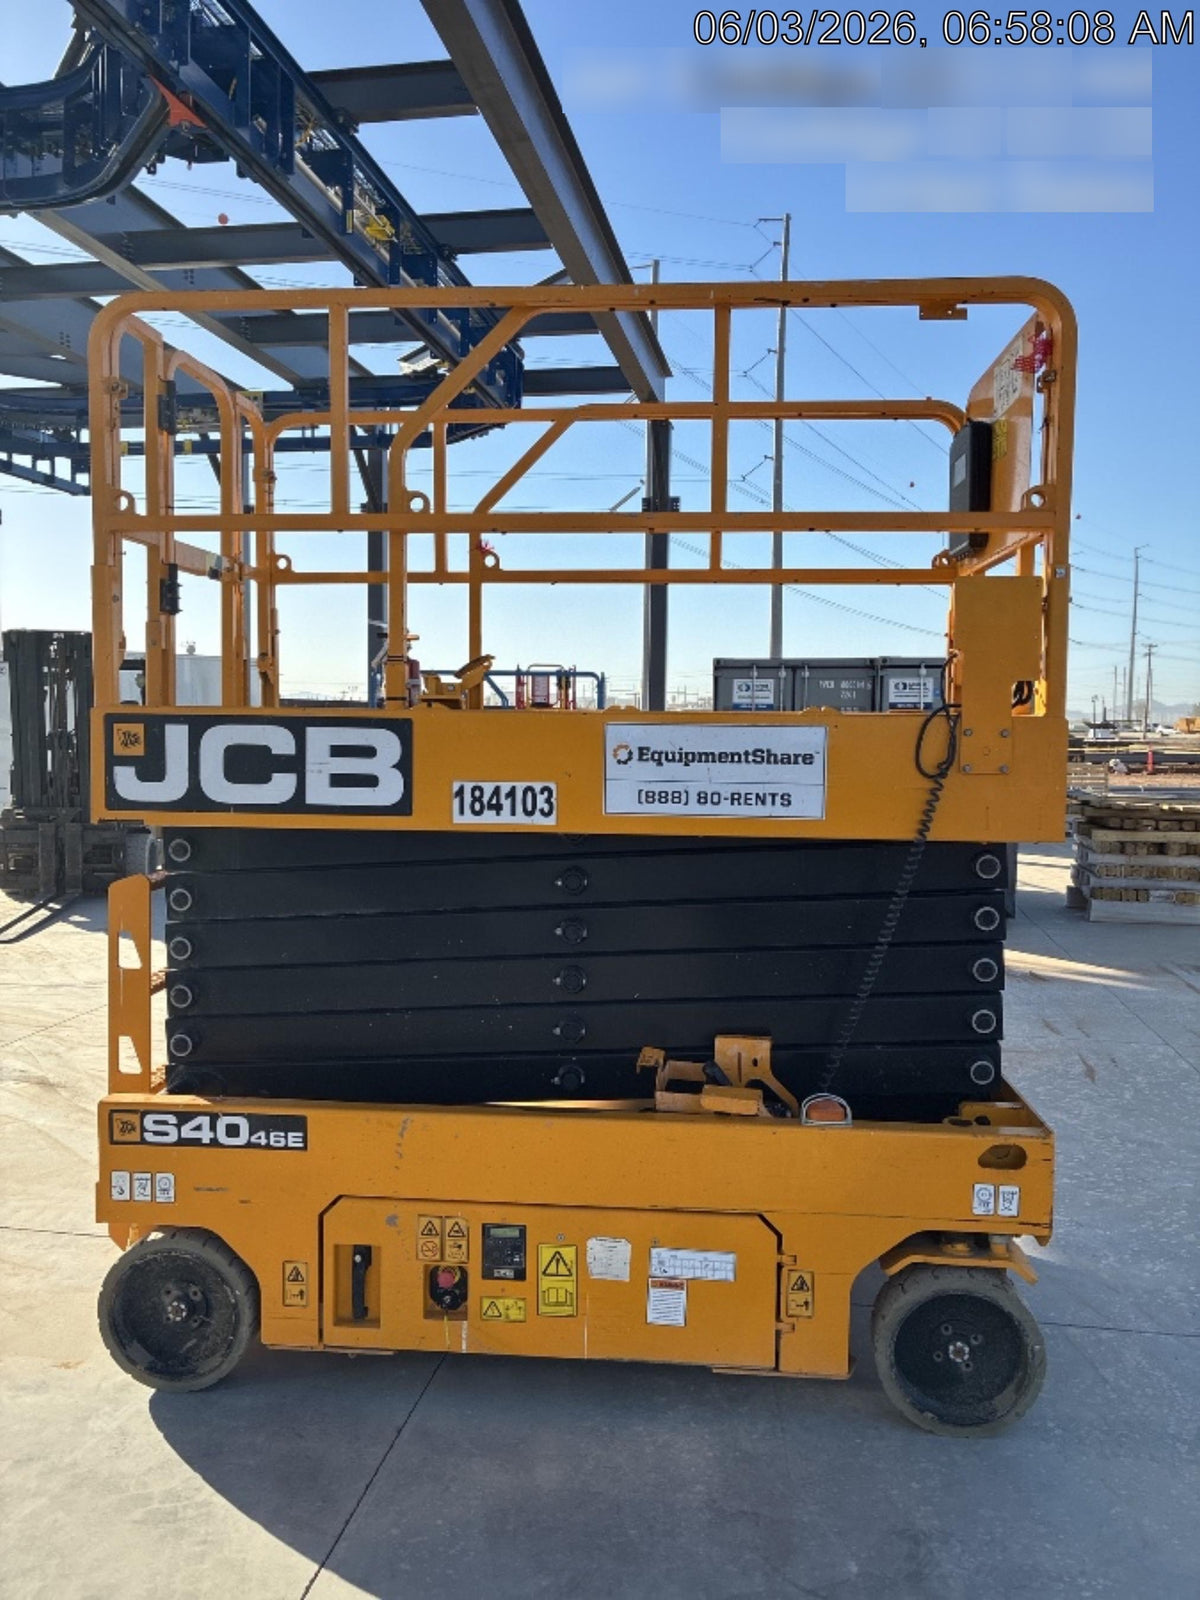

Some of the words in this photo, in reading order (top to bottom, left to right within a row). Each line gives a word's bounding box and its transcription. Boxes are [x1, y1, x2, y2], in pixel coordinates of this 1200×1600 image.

[113, 723, 405, 806] JCB
[637, 746, 814, 767] EquipmentShare
[454, 784, 555, 818] 184103
[696, 790, 792, 808] 80-RENTS
